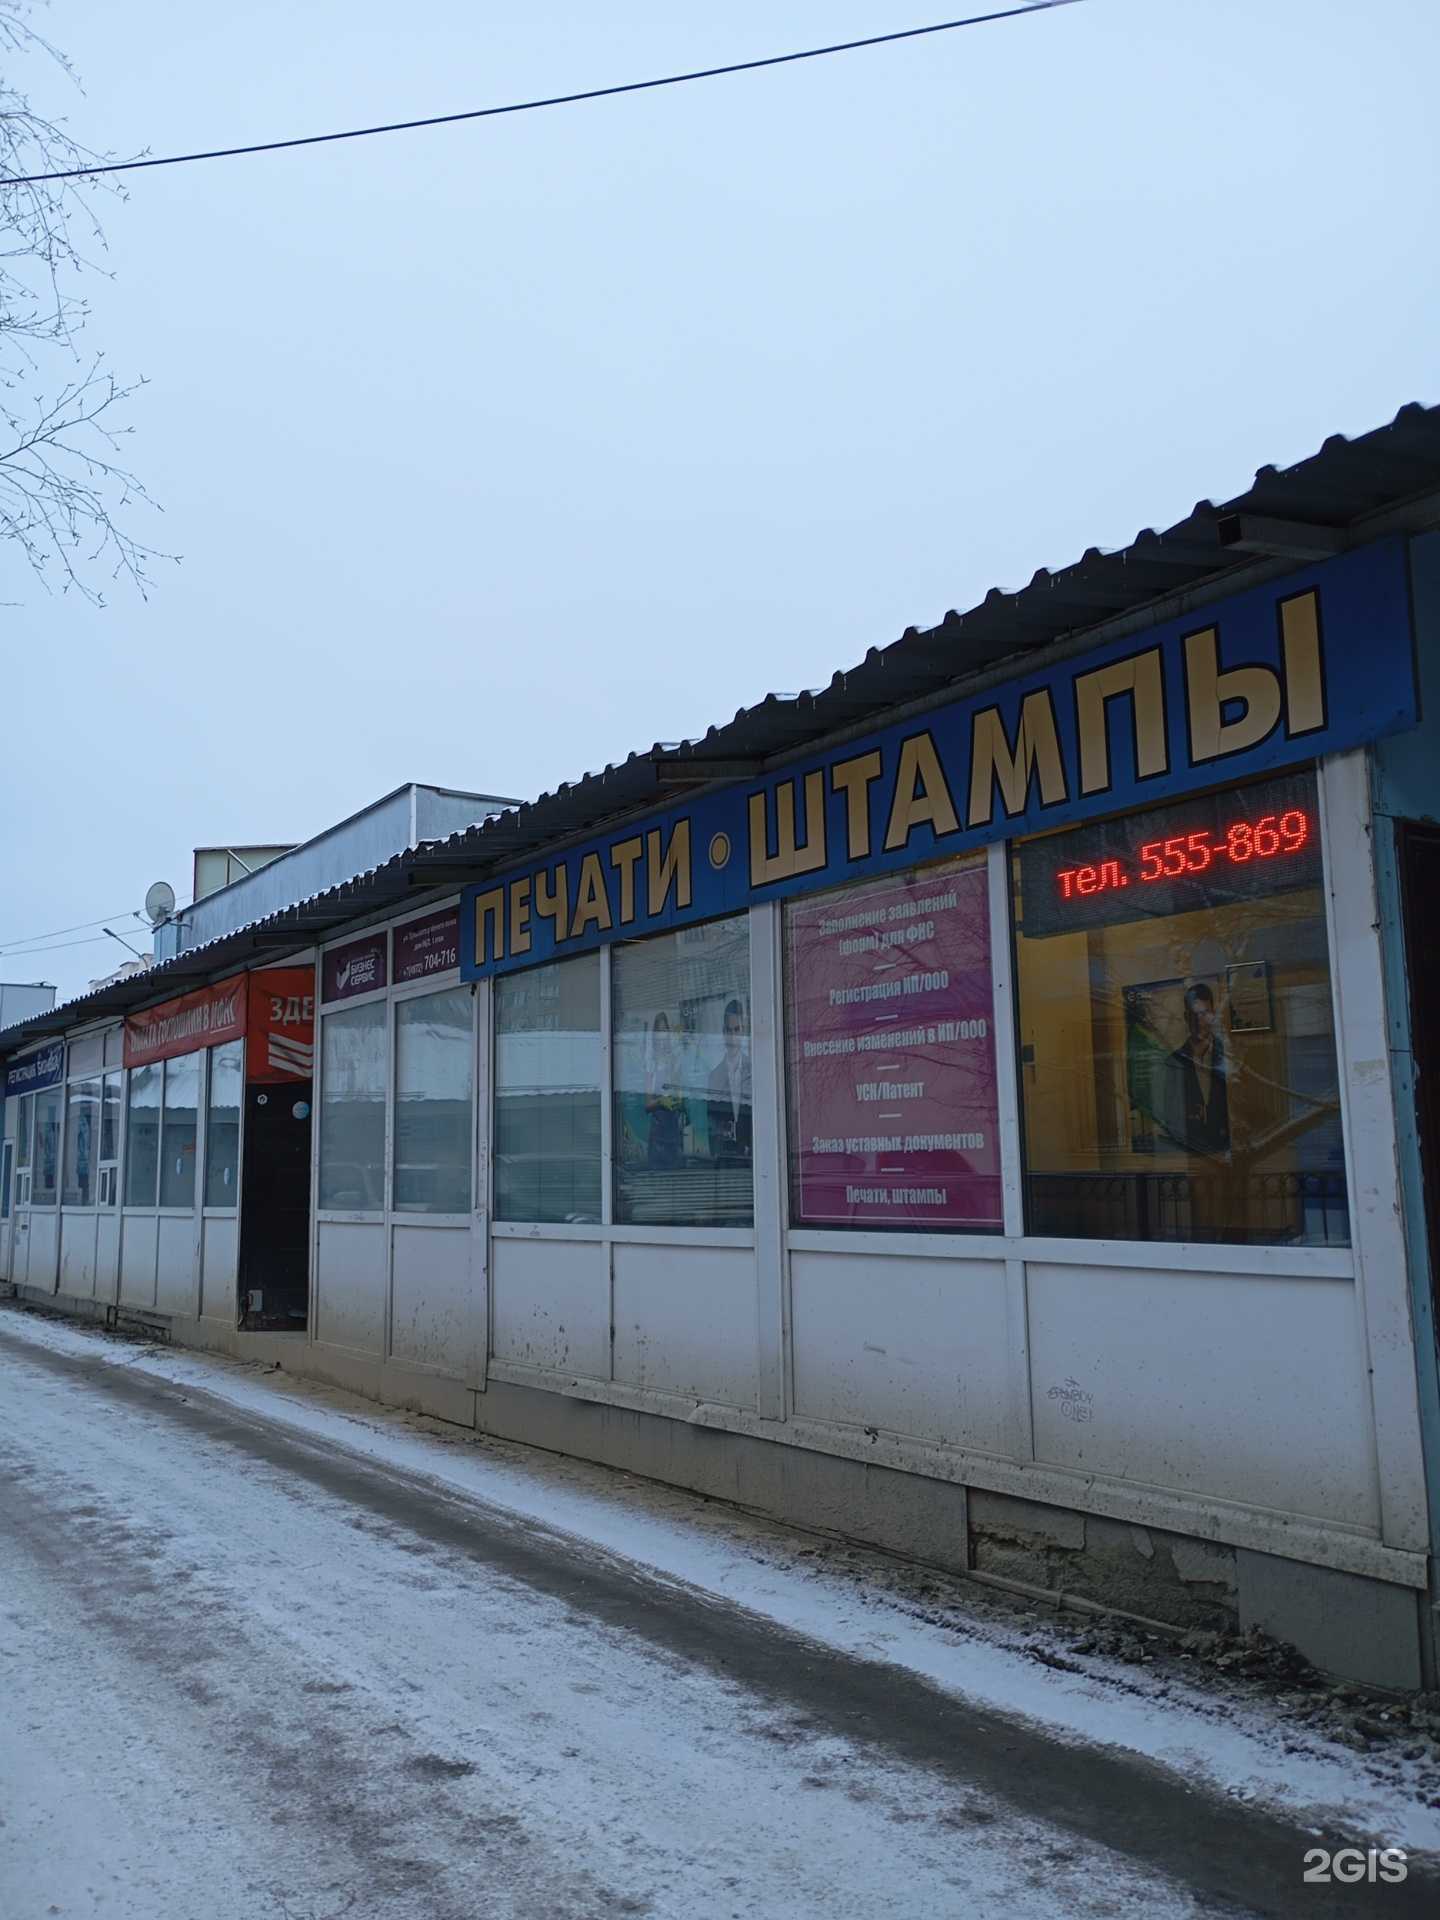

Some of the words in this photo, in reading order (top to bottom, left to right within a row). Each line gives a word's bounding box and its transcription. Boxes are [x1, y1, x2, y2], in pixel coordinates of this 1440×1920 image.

[473, 816, 693, 967] ПЕЧАТИ
[748, 586, 1327, 887] ШТАМПЫ
[1057, 859, 1128, 898] тел.
[1140, 810, 1309, 881] 555-869
[819, 909, 886, 937] Заполнение
[888, 888, 957, 921] заявлений
[906, 920, 935, 943] ФНС
[424, 947, 456, 970] 704-716
[830, 981, 901, 1006] Регистрация
[903, 970, 949, 995] ИП/ООО
[804, 1037, 855, 1057] Внесение
[857, 1026, 925, 1051] изменений
[927, 1027, 935, 1043] в
[937, 1018, 987, 1042] ИП/ООО
[856, 1082, 924, 1101] УСН/Патент
[812, 1136, 846, 1153] Заказ
[846, 1134, 901, 1154] уставных
[903, 1132, 984, 1153] документов
[846, 1185, 890, 1205] Печати,
[892, 1188, 947, 1205] штампы
